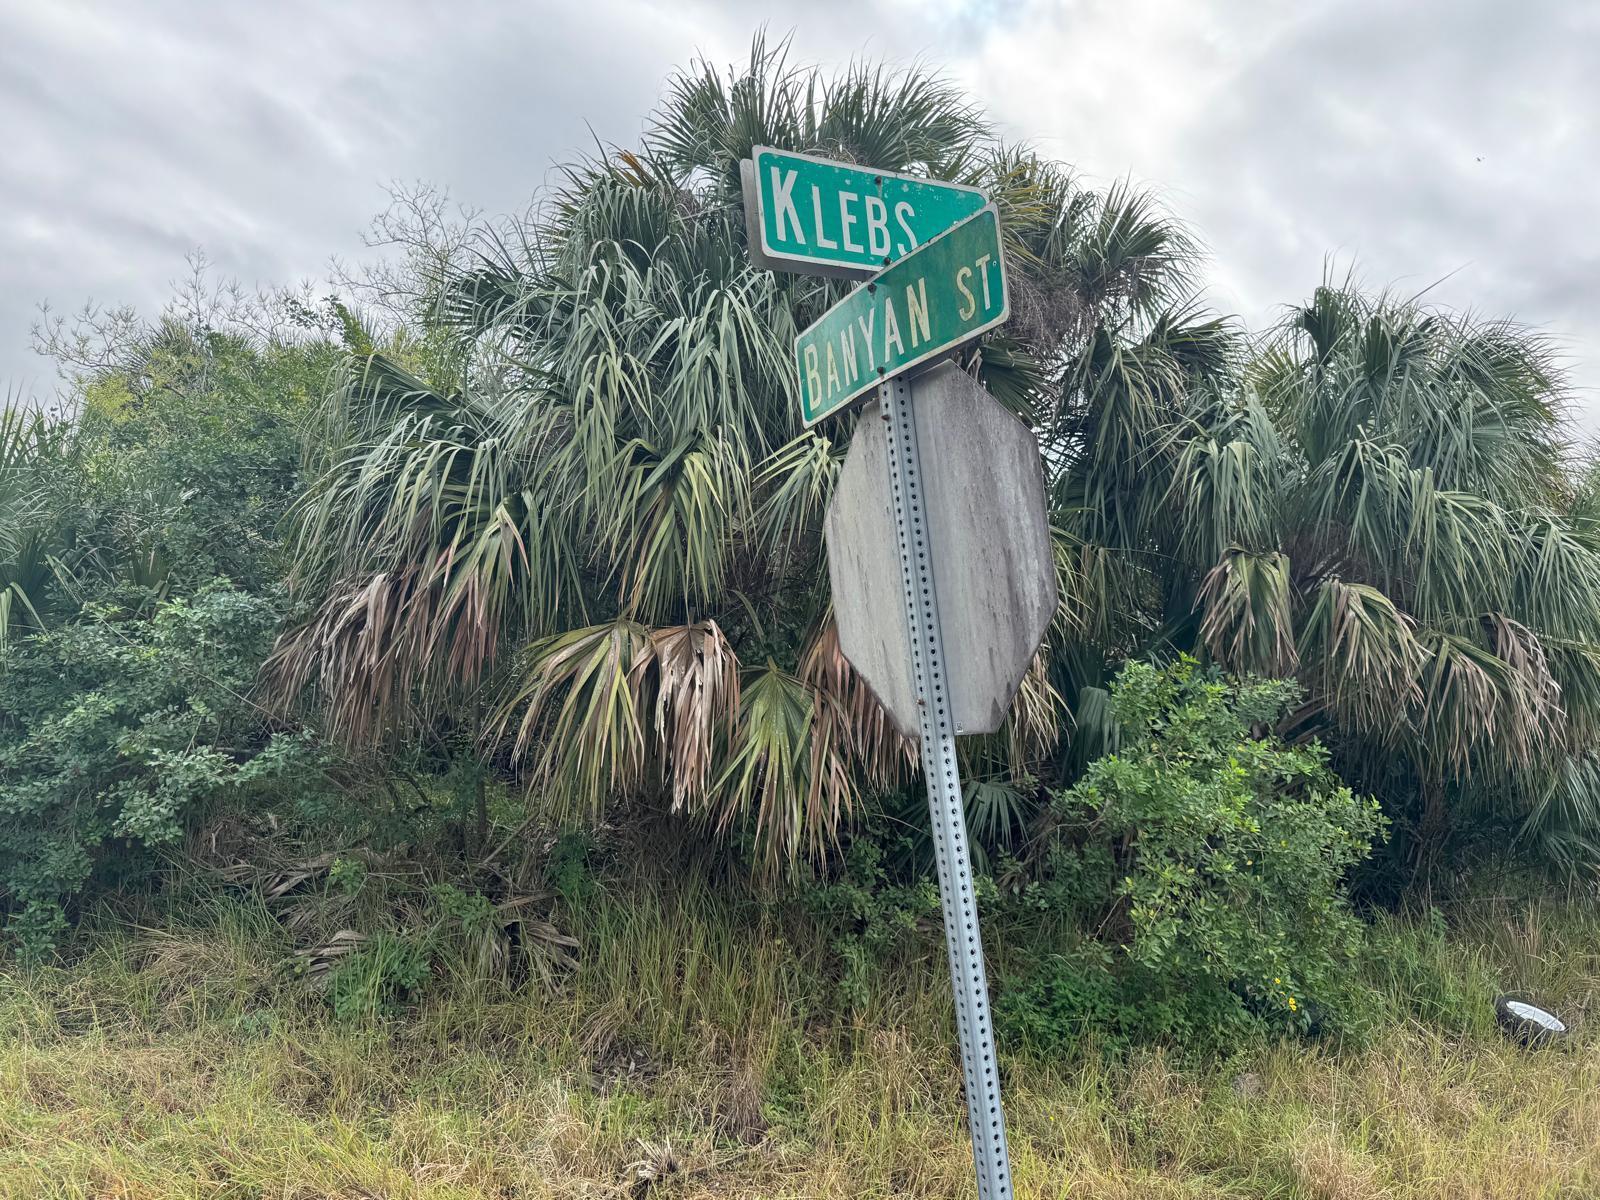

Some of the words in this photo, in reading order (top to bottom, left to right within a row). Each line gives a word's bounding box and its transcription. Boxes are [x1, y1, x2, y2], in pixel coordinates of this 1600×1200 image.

[771, 167, 918, 257] KLEBS
[805, 278, 931, 411] BANYAN
[957, 254, 990, 321] ST
